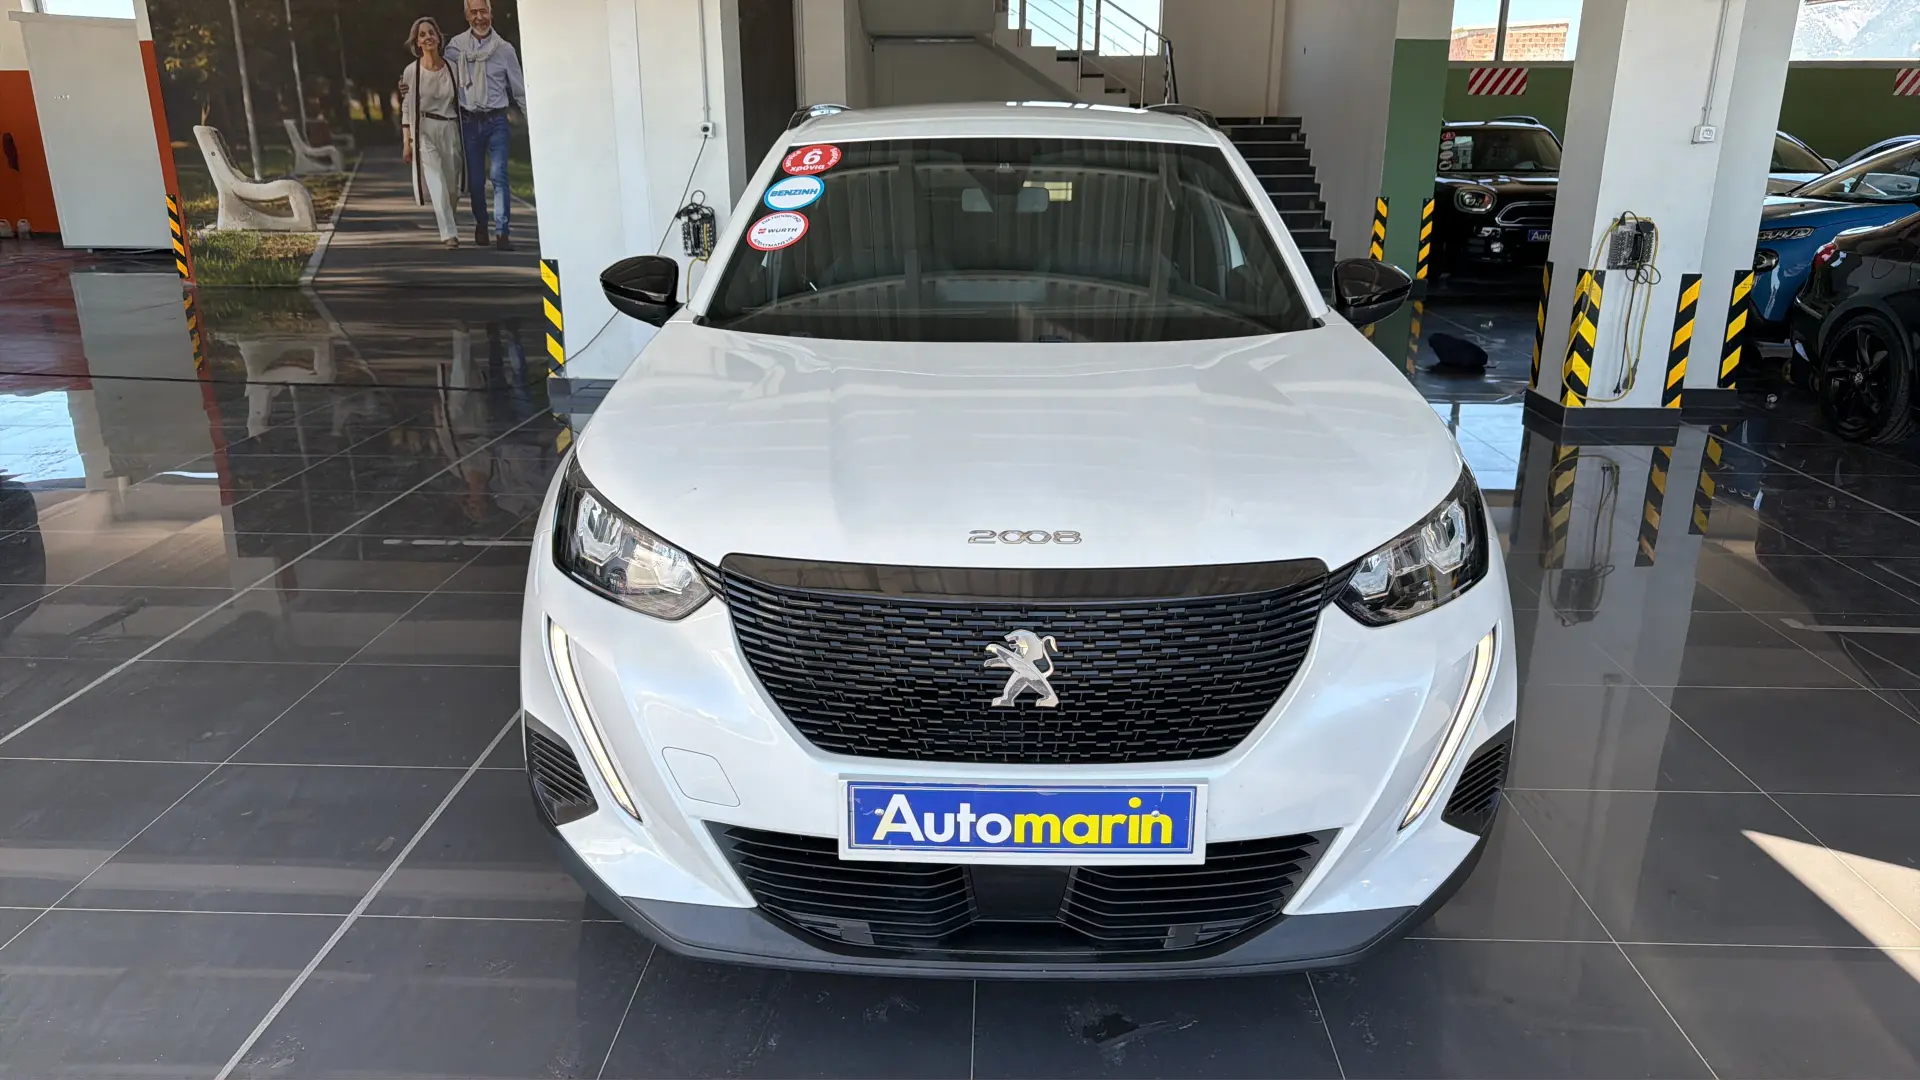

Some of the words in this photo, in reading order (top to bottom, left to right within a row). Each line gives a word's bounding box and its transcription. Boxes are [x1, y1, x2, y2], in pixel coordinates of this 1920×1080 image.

[802, 149, 822, 165] 6
[968, 530, 1082, 544] 2008
[872, 794, 1173, 844] Automarin
